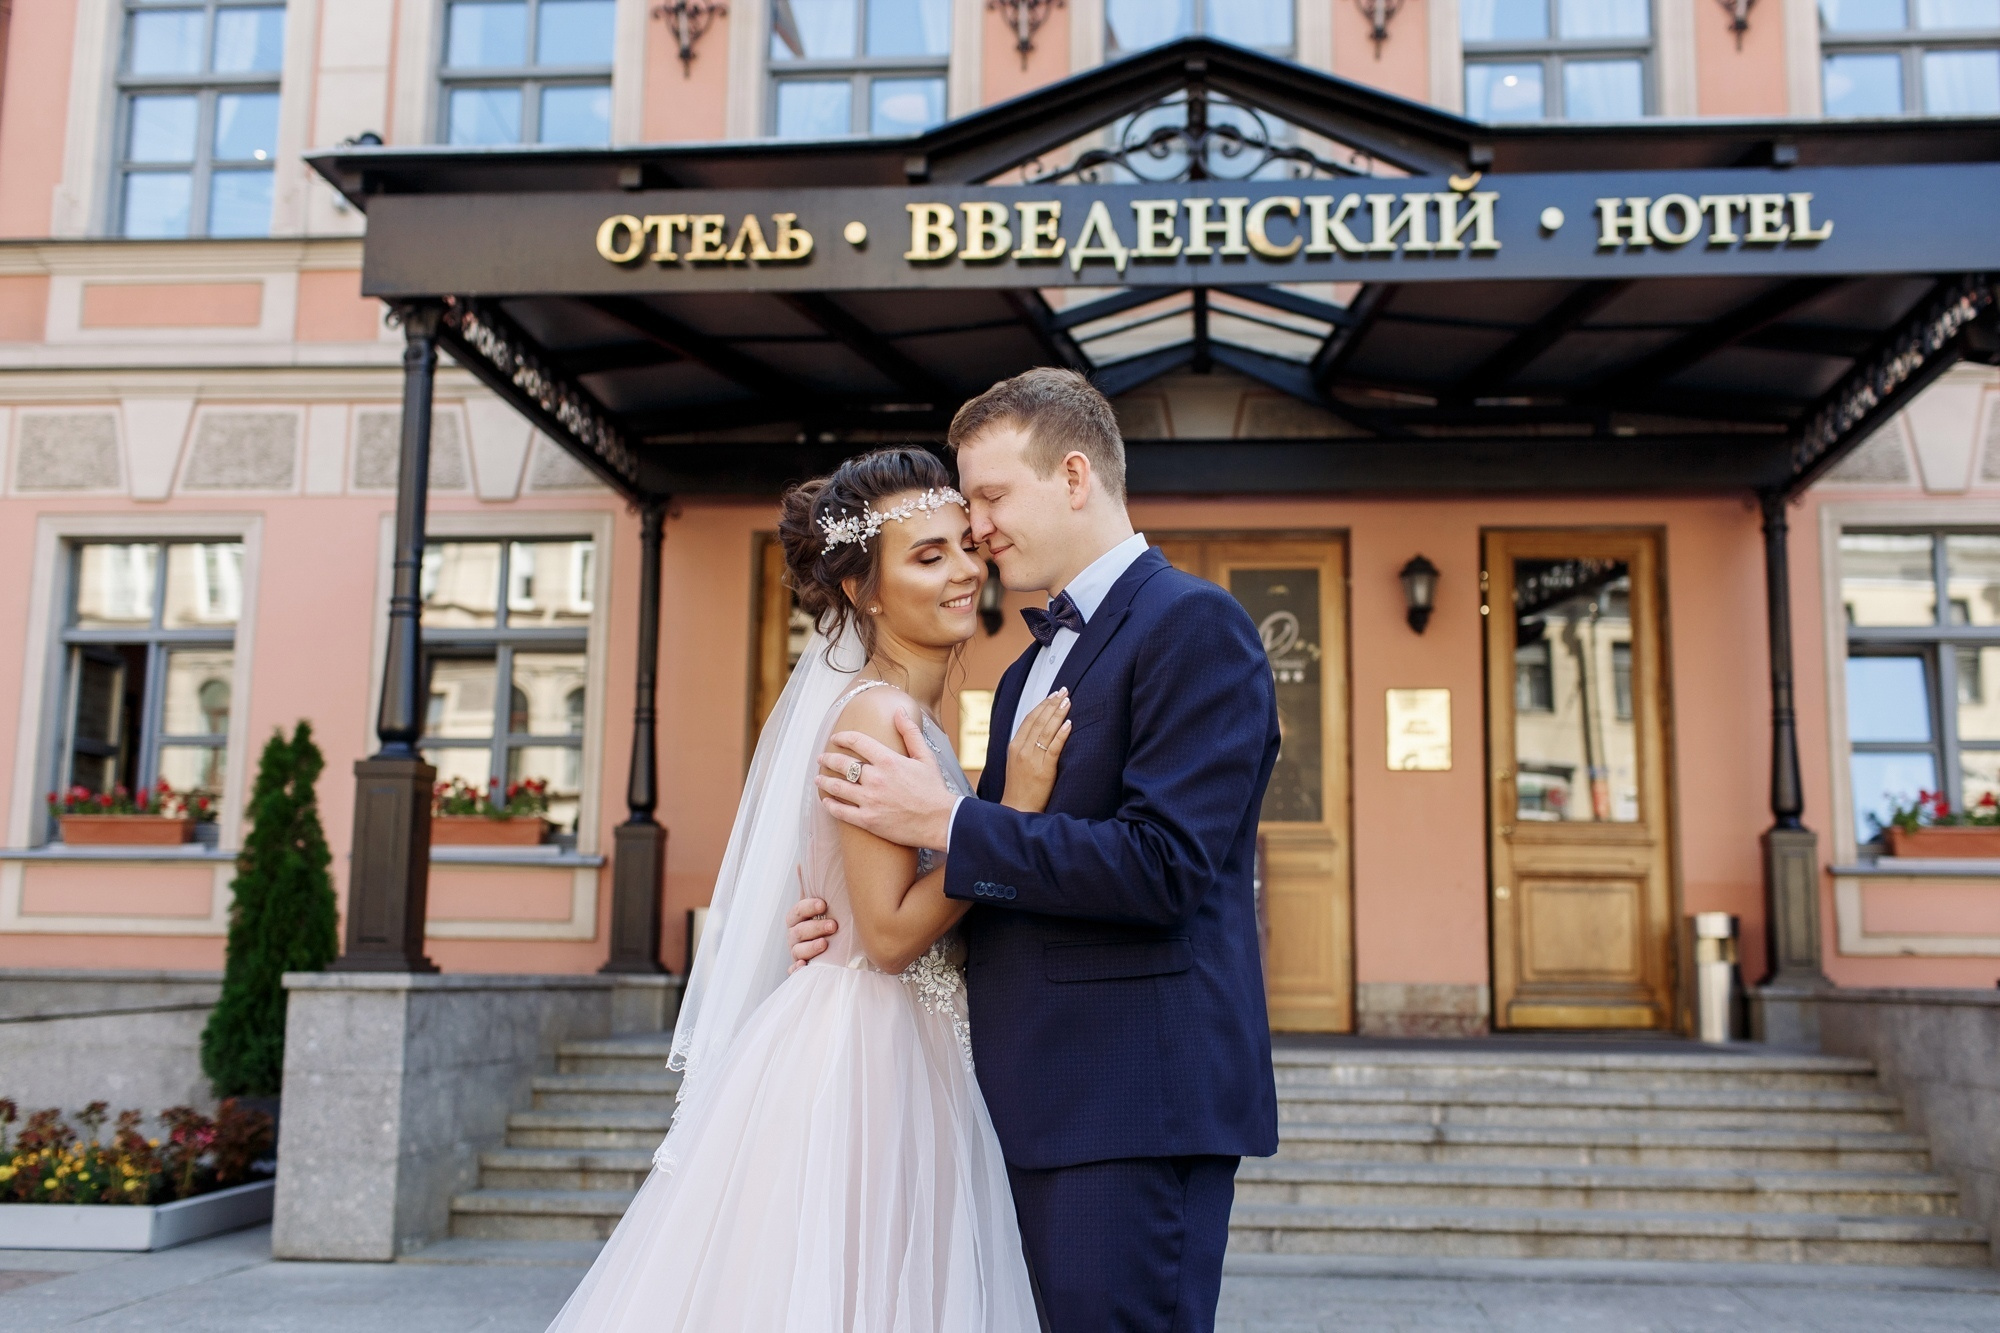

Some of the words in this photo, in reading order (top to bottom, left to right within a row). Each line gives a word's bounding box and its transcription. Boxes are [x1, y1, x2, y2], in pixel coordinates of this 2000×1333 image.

[597, 213, 814, 262] ОТЕЛЬ
[904, 172, 1501, 272] ВВЕДЕНСКИЙ
[1597, 192, 1834, 247] HOTEL
